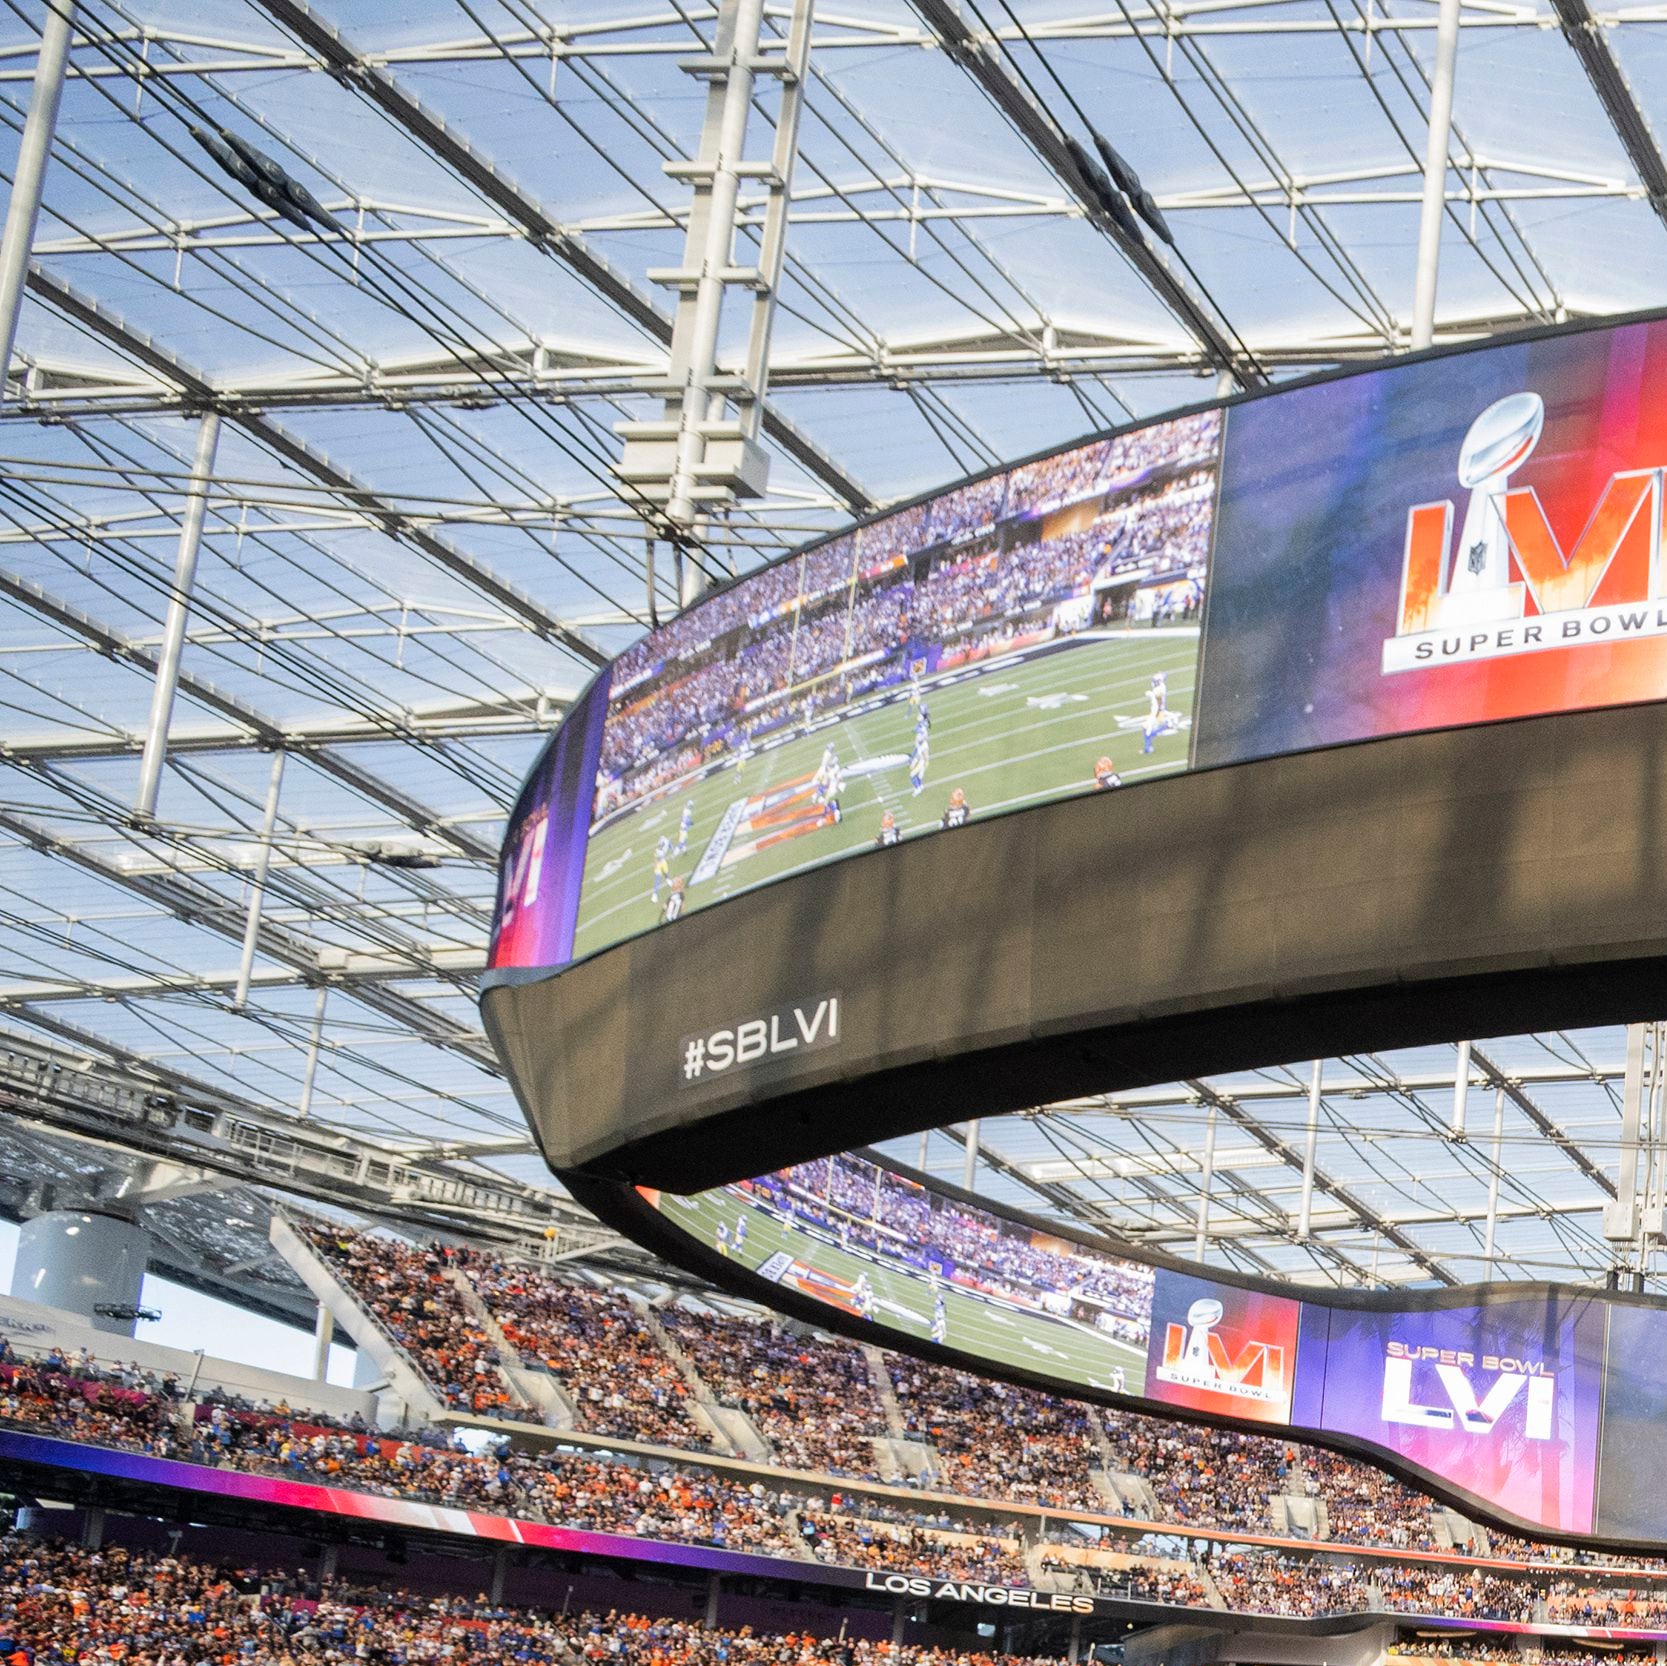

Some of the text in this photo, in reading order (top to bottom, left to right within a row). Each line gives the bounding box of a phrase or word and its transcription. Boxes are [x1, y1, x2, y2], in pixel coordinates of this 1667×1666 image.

[1412, 618, 1548, 665] SUPER
[682, 996, 841, 1082] #SBLVI
[1164, 1324, 1284, 1388] LVI
[1386, 1341, 1556, 1379] SUPER BOWL
[1379, 1358, 1555, 1442] LVI
[866, 1572, 1095, 1613] LOS ANGELES
